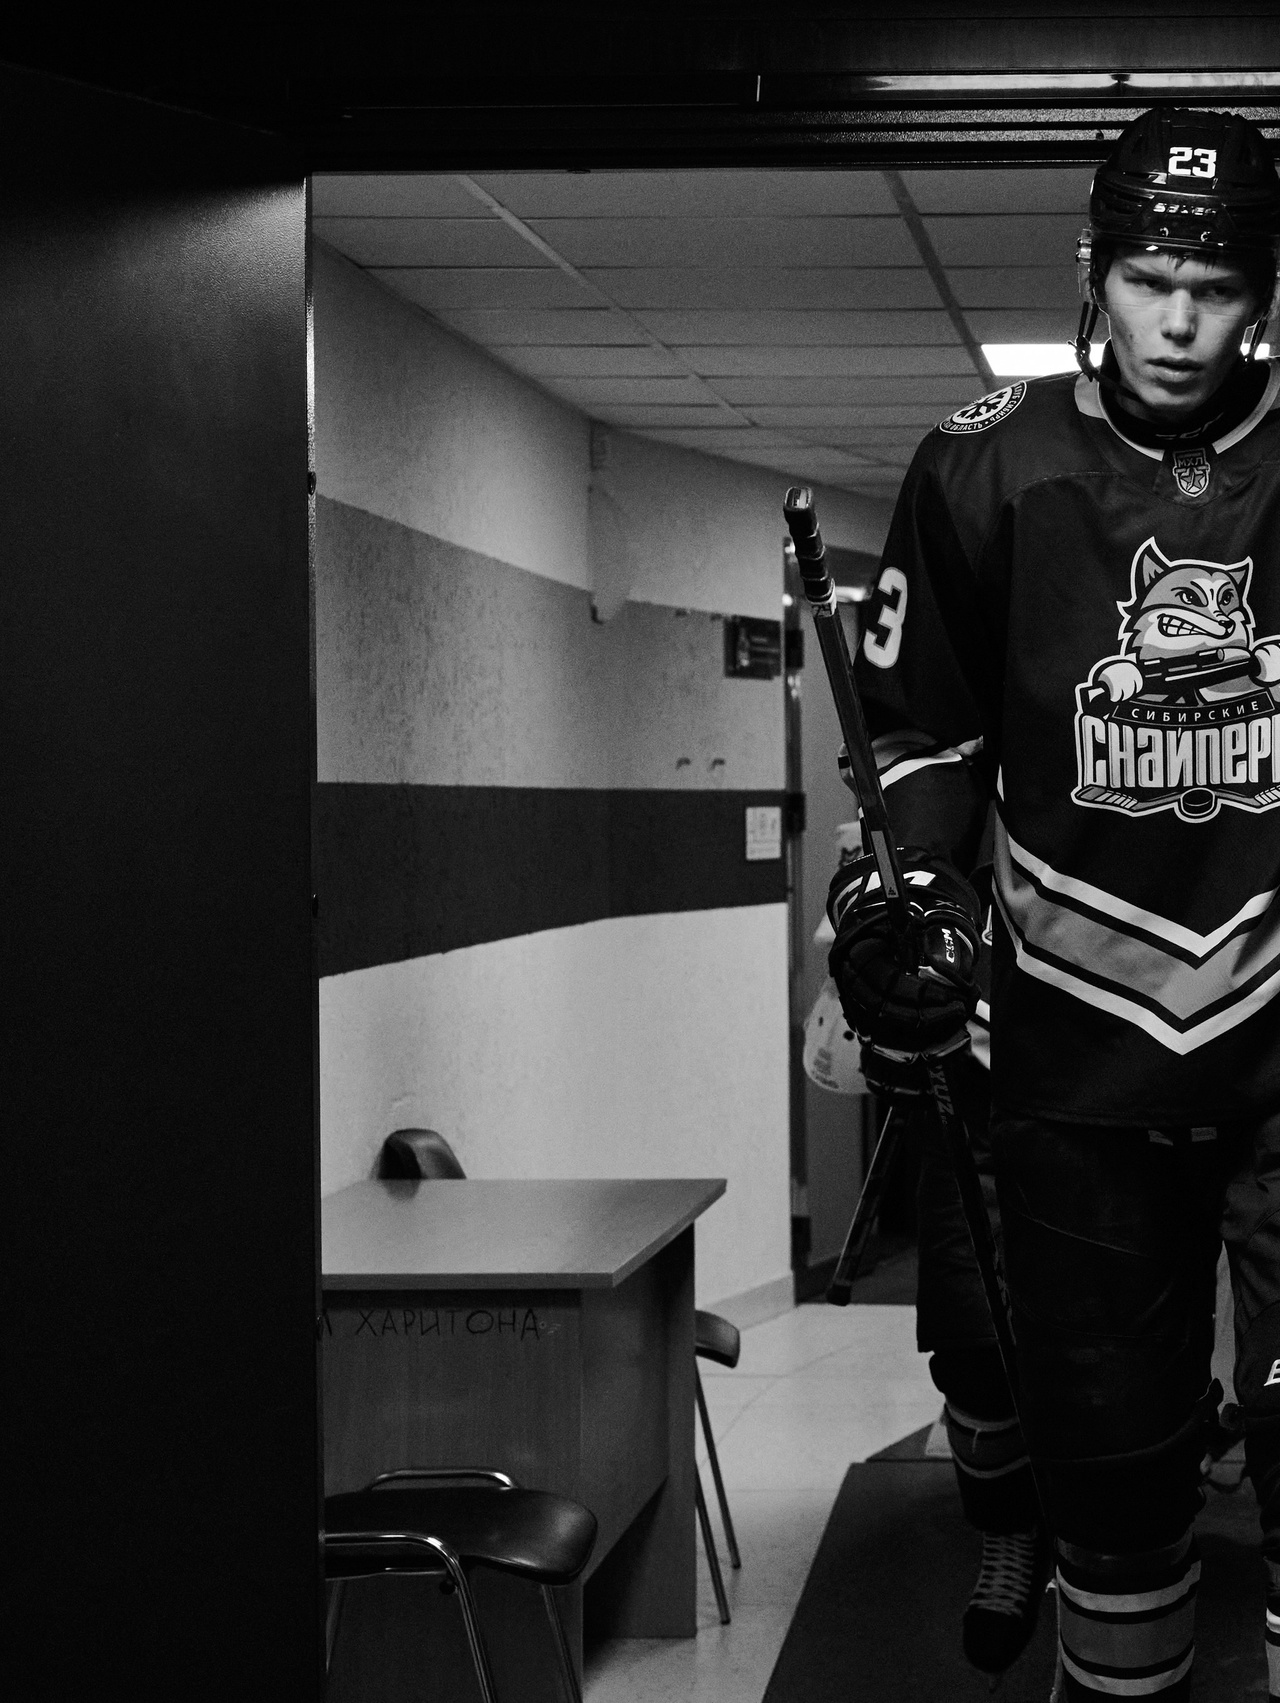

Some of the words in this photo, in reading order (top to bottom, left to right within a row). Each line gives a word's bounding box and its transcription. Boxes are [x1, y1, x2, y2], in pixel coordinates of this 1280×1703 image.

[1168, 146, 1217, 178] 23
[863, 567, 908, 669] 3
[1131, 701, 1259, 722] СИБИРСКИЕ
[355, 1308, 540, 1341] ХАРИТОНА
